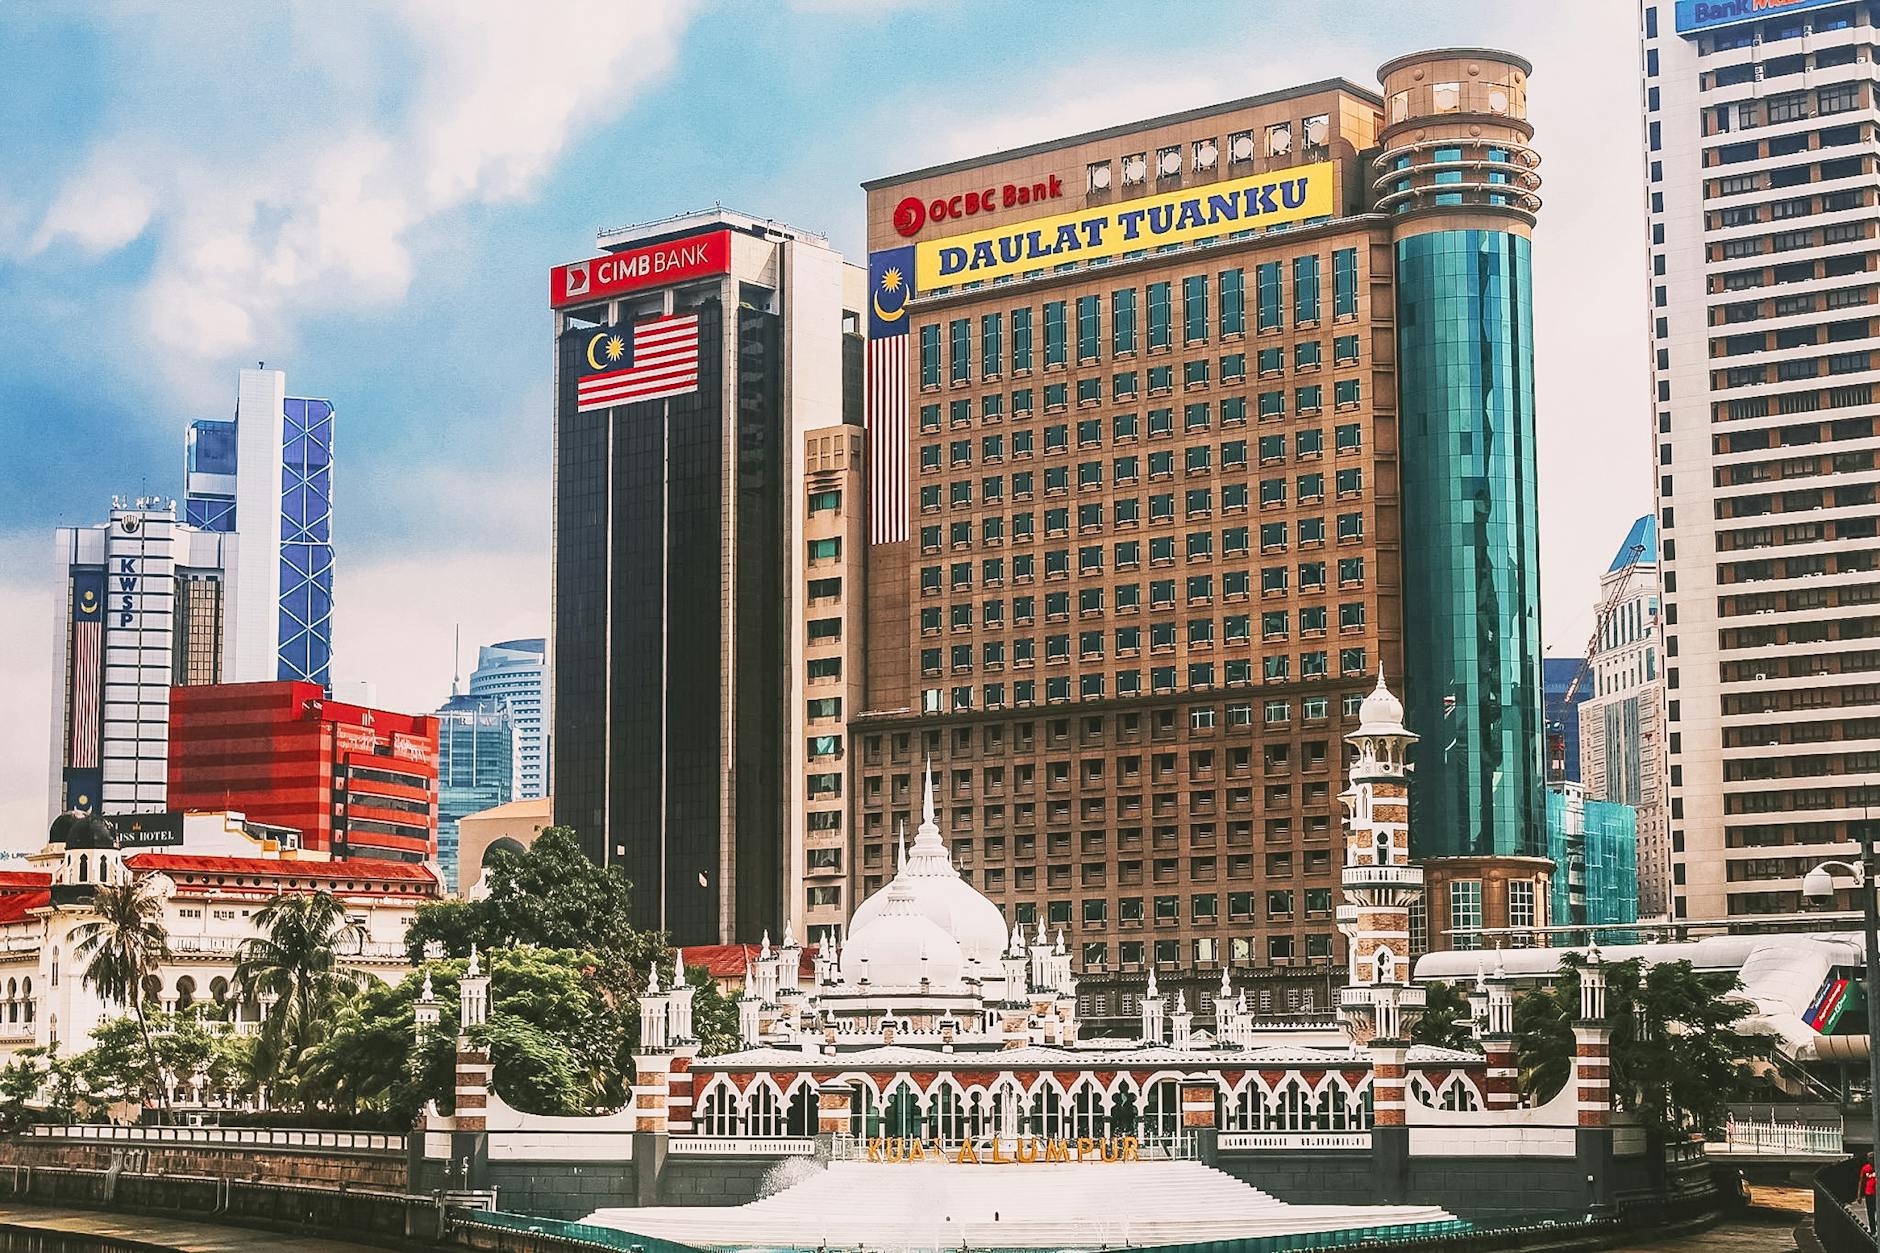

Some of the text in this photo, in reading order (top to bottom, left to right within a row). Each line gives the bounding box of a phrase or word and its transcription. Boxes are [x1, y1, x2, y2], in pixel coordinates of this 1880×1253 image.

[1695, 0, 1748, 22] Bank
[929, 174, 1062, 222] OCBC Bank
[939, 177, 1308, 276] DAULAT TUANKU
[598, 243, 709, 284] CIMB BANK
[119, 558, 138, 628] KWSP
[139, 830, 174, 841] HOTEL
[992, 1135, 1140, 1162] LUMPUR
